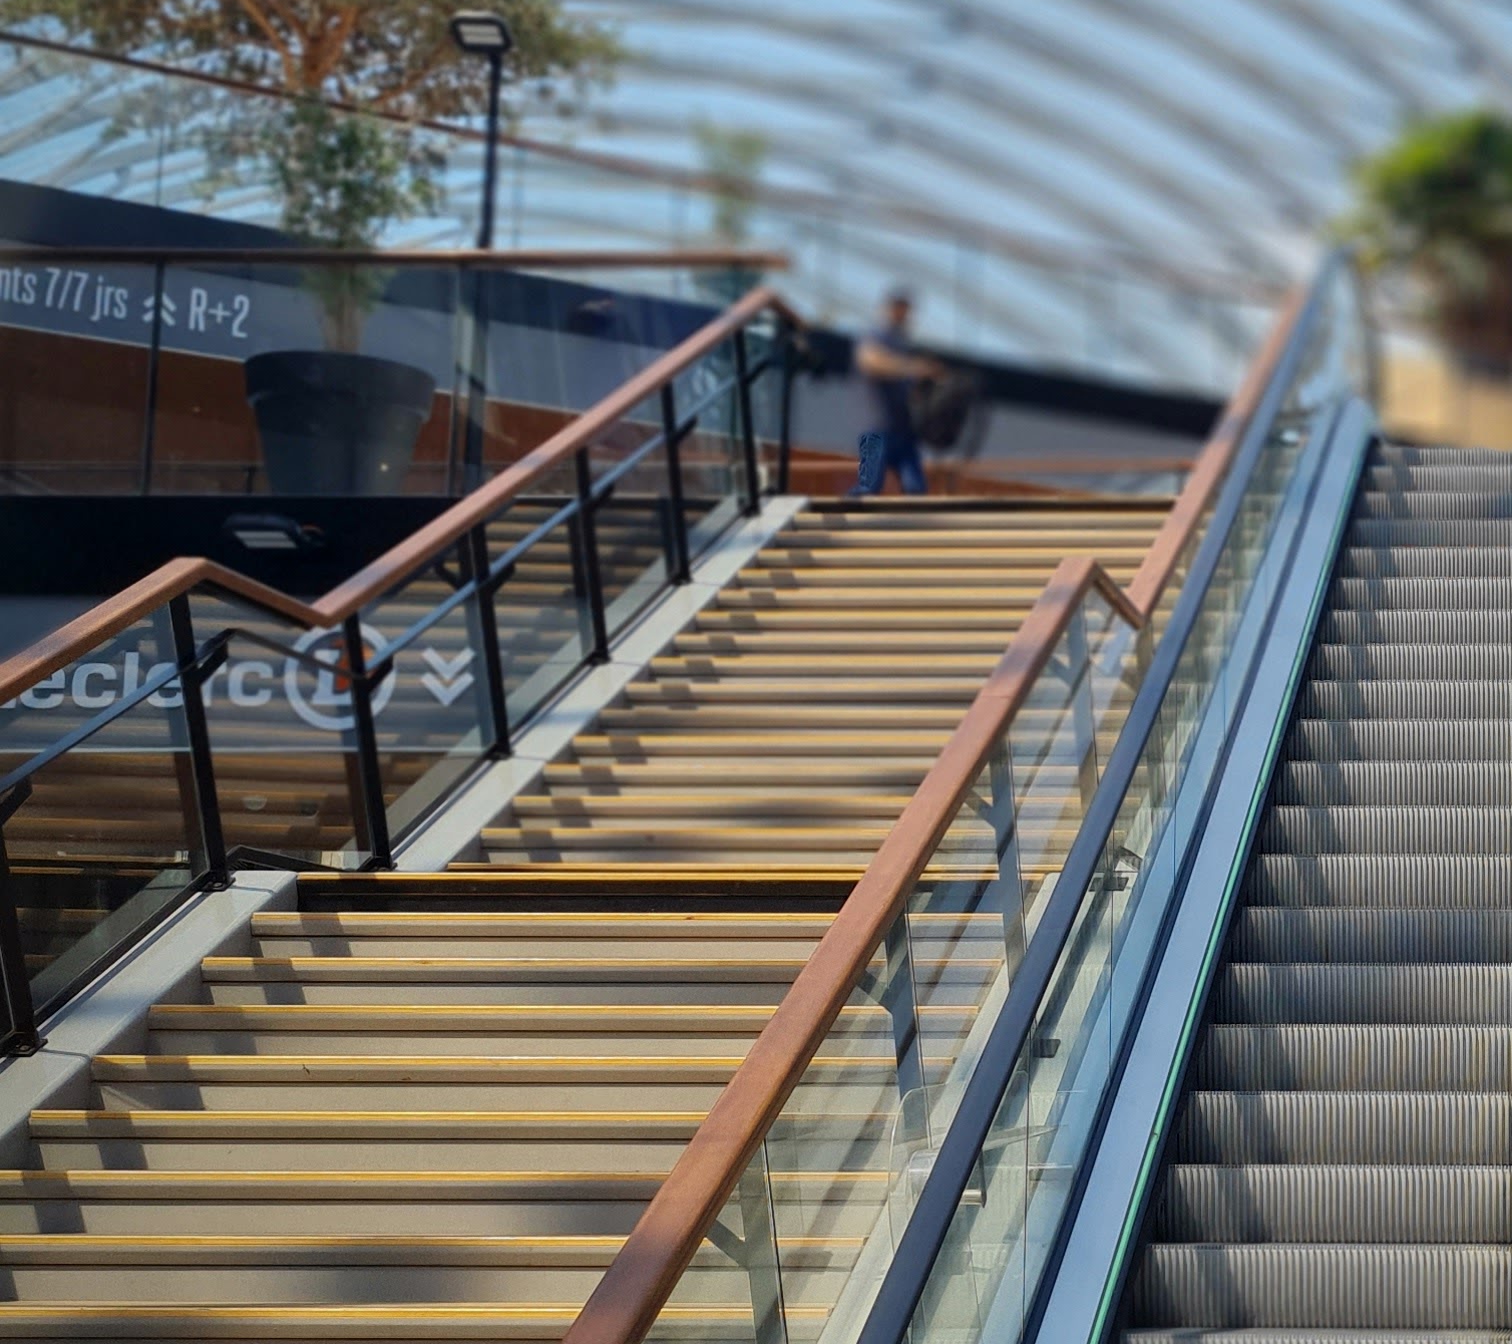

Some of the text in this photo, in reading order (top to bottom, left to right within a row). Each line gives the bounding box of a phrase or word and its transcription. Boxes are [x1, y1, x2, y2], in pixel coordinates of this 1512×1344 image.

[45, 268, 89, 312] 7/7
[90, 276, 129, 322] jrs
[188, 287, 250, 338] R+2
[0, 651, 272, 710] eclerc
